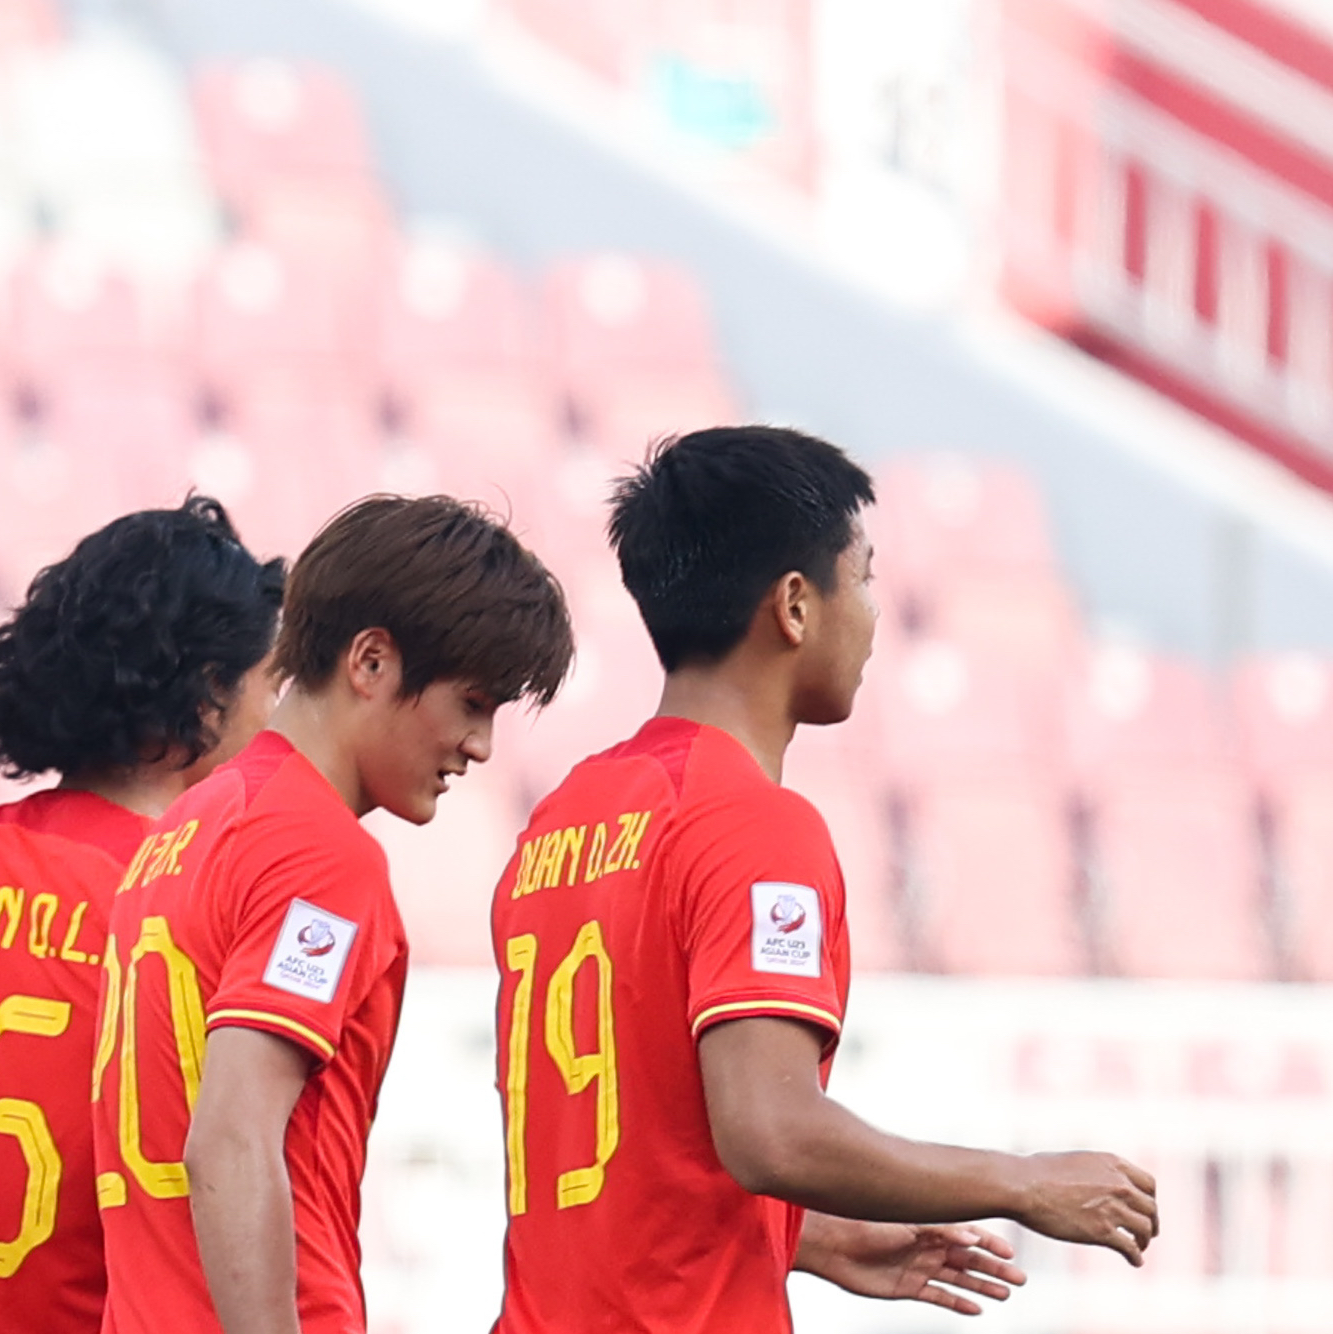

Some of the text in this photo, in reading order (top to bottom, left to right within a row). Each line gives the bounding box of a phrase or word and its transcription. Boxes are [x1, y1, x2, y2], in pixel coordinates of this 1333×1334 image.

[511, 824, 587, 900] DUAN
[29, 893, 99, 965] Q.L.
[506, 920, 619, 1216] 19
